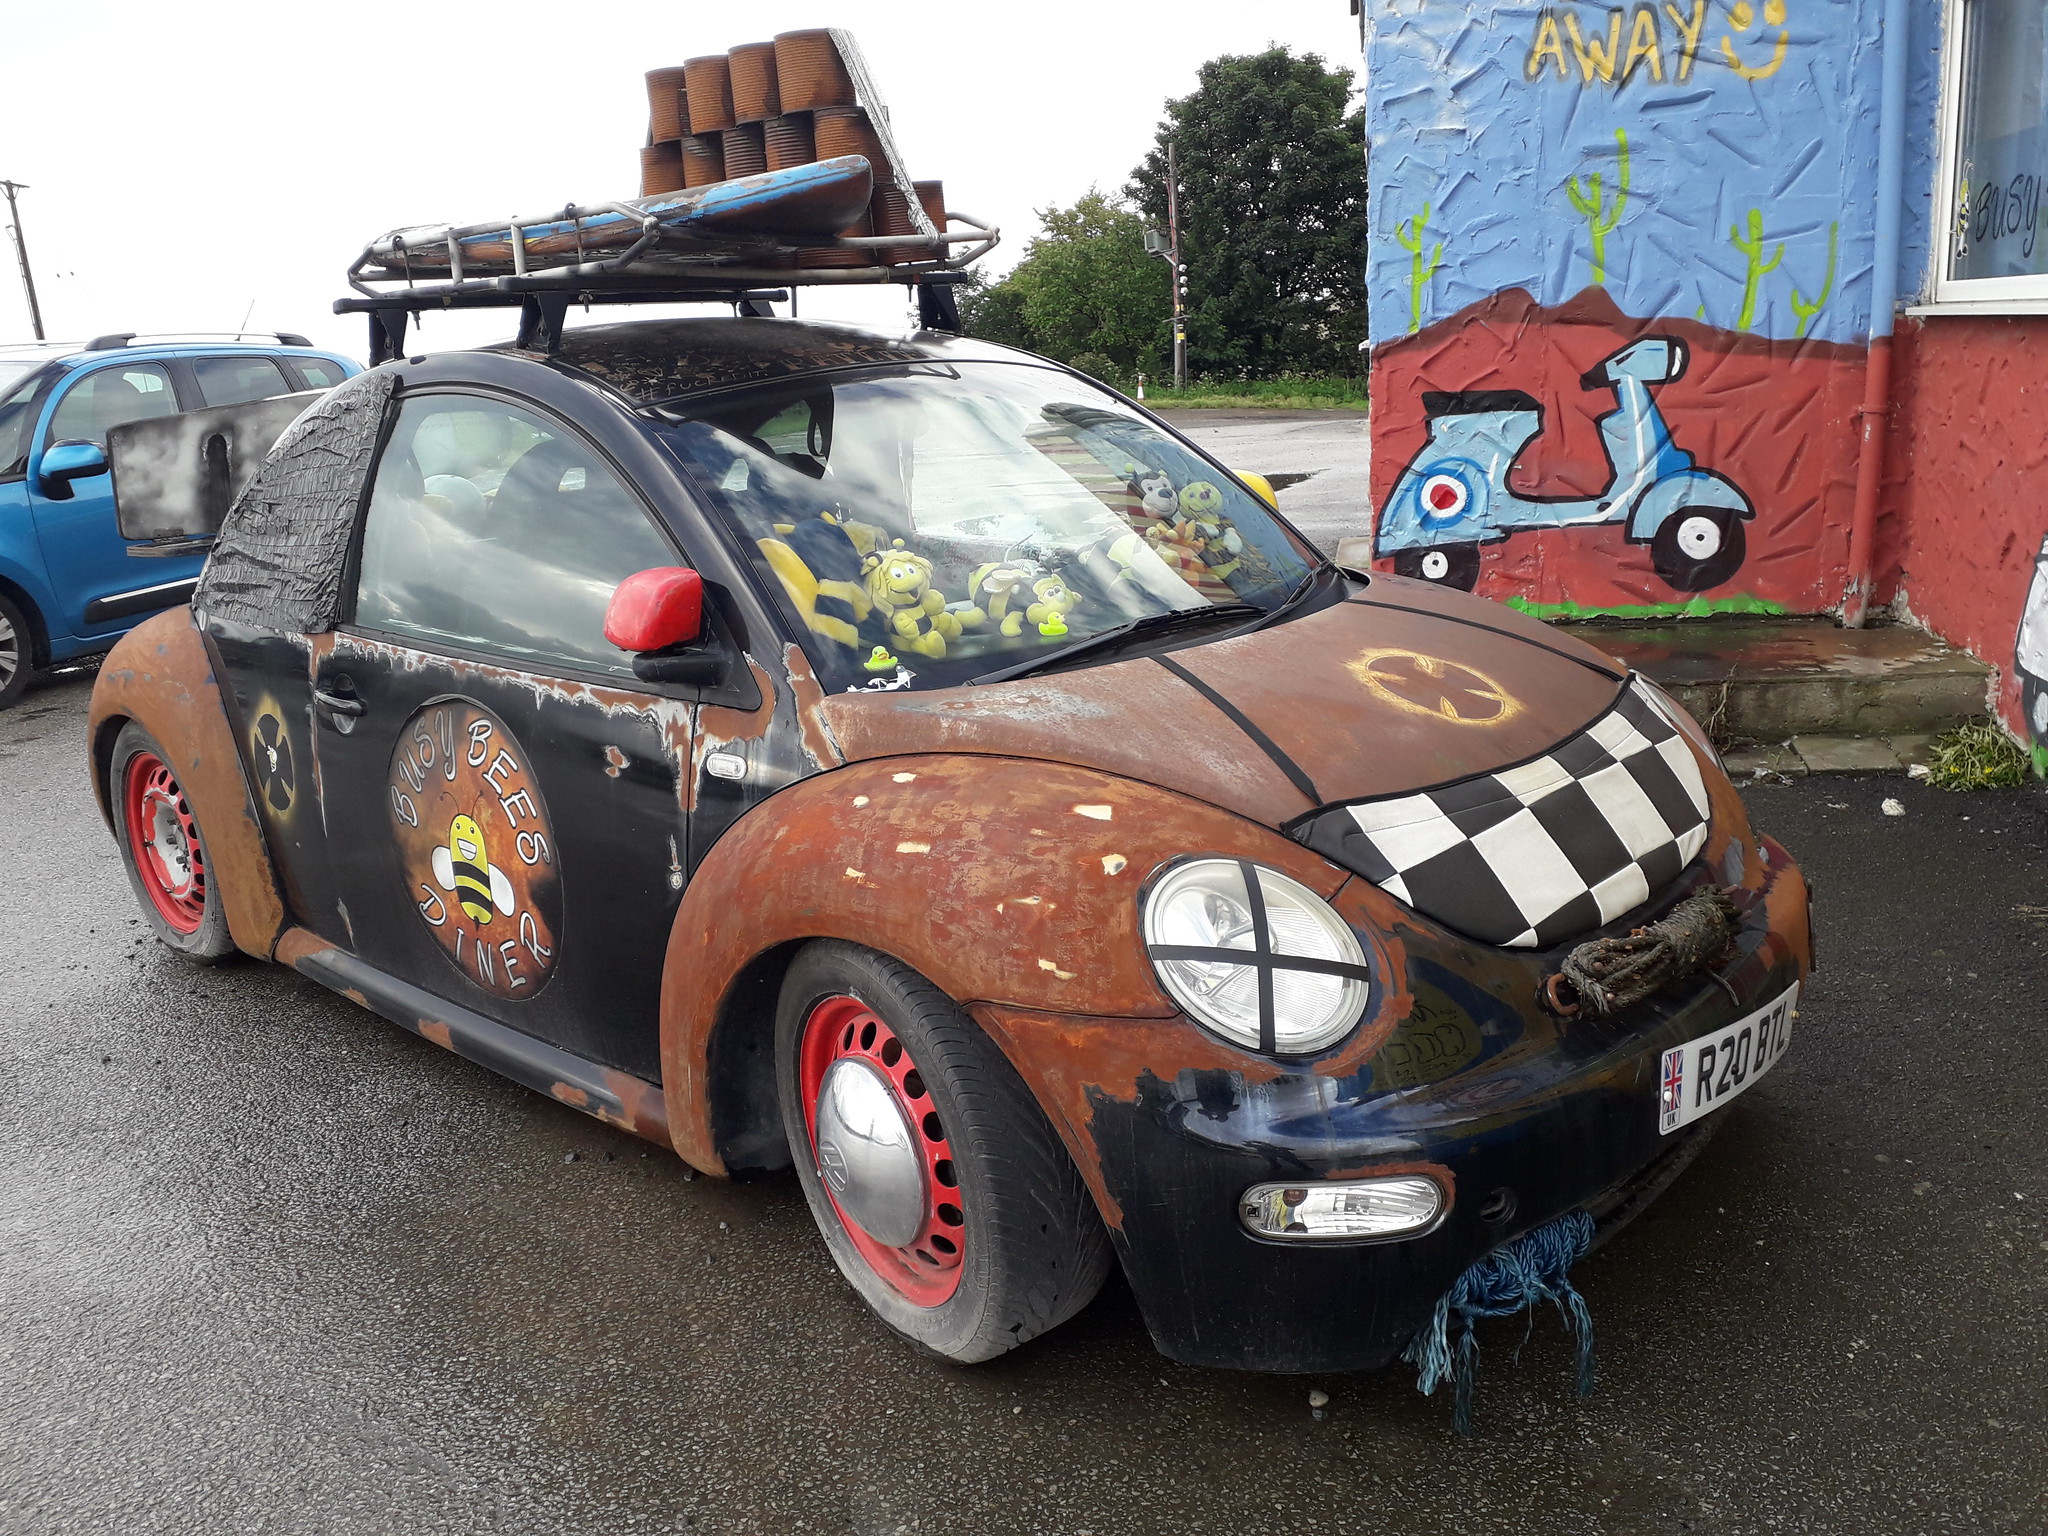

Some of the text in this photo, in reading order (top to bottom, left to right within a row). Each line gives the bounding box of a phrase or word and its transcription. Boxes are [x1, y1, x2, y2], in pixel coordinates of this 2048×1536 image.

[1525, 0, 1707, 86] AWAY
[391, 709, 551, 865] BUSY BEES
[418, 884, 552, 989] DINER
[1695, 1001, 1788, 1108] R20 BTL
[1666, 1112, 1677, 1127] UK
